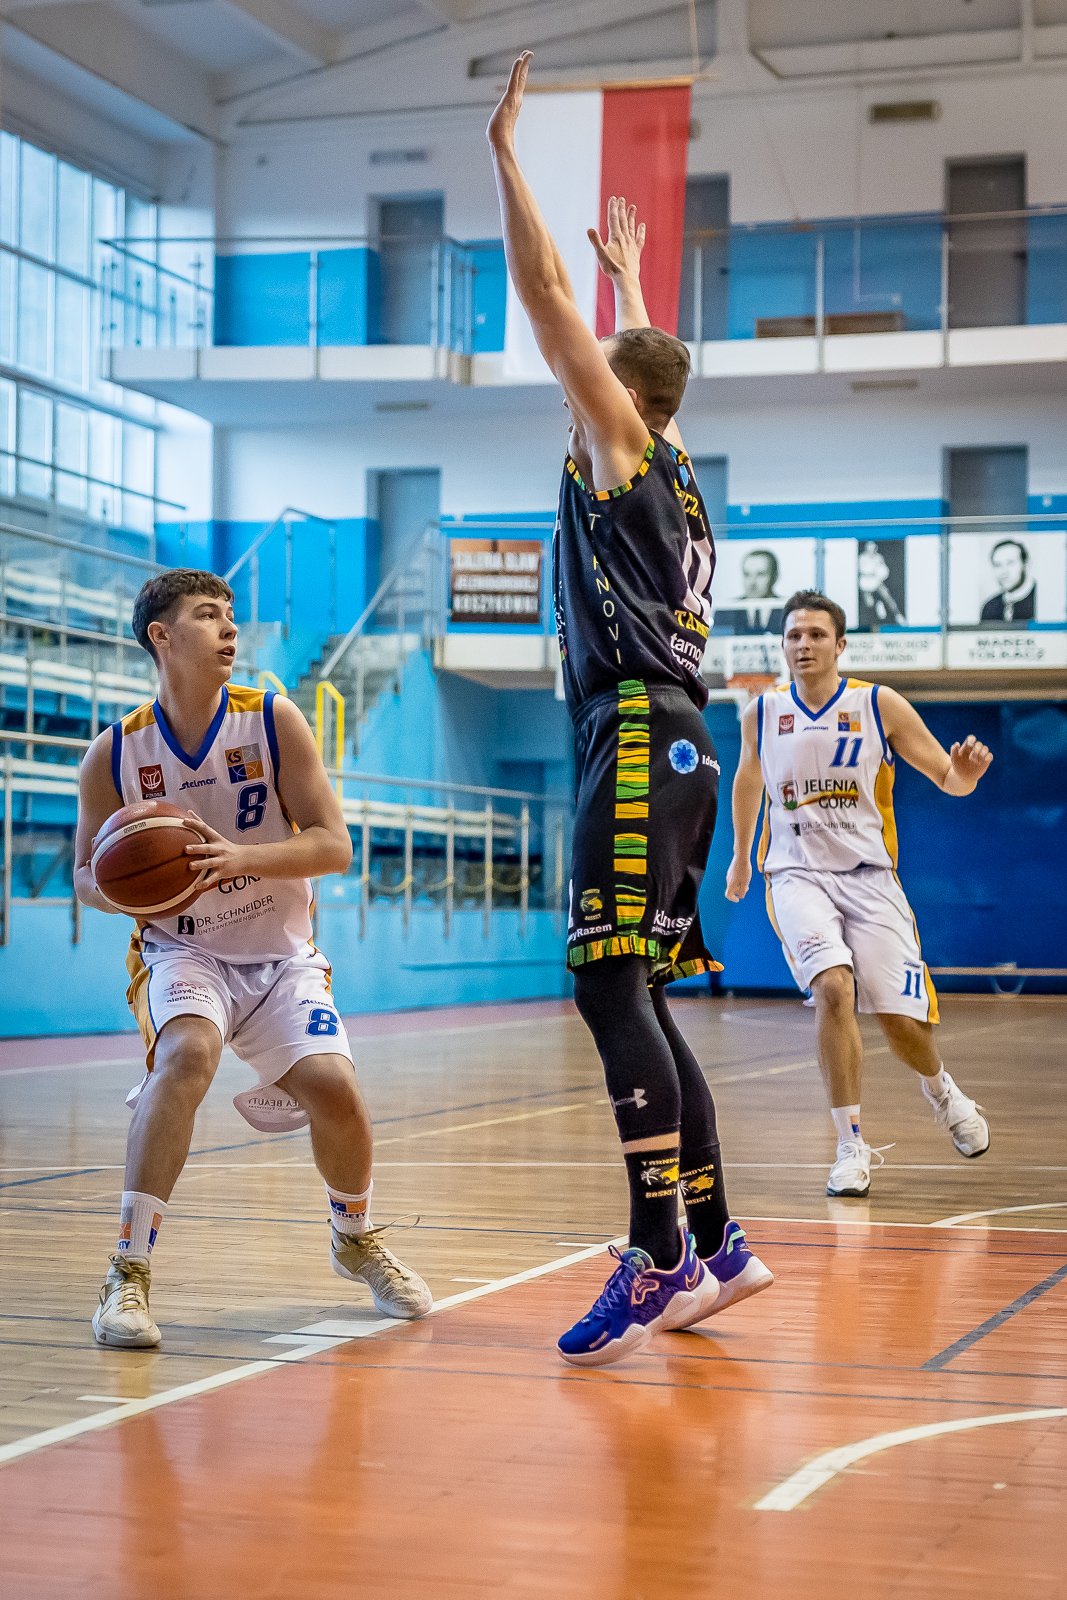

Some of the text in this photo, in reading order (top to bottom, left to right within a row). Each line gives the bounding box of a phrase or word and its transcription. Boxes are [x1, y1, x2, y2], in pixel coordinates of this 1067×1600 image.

[829, 736, 864, 768] 11
[803, 778, 859, 795] JELENIA
[235, 781, 269, 834] 8
[196, 894, 274, 928] DR. SCHNEIDER
[198, 906, 277, 935] UNTERNEHMENSGRUPPE
[901, 970, 922, 999] 11
[305, 1008, 339, 1037] 8
